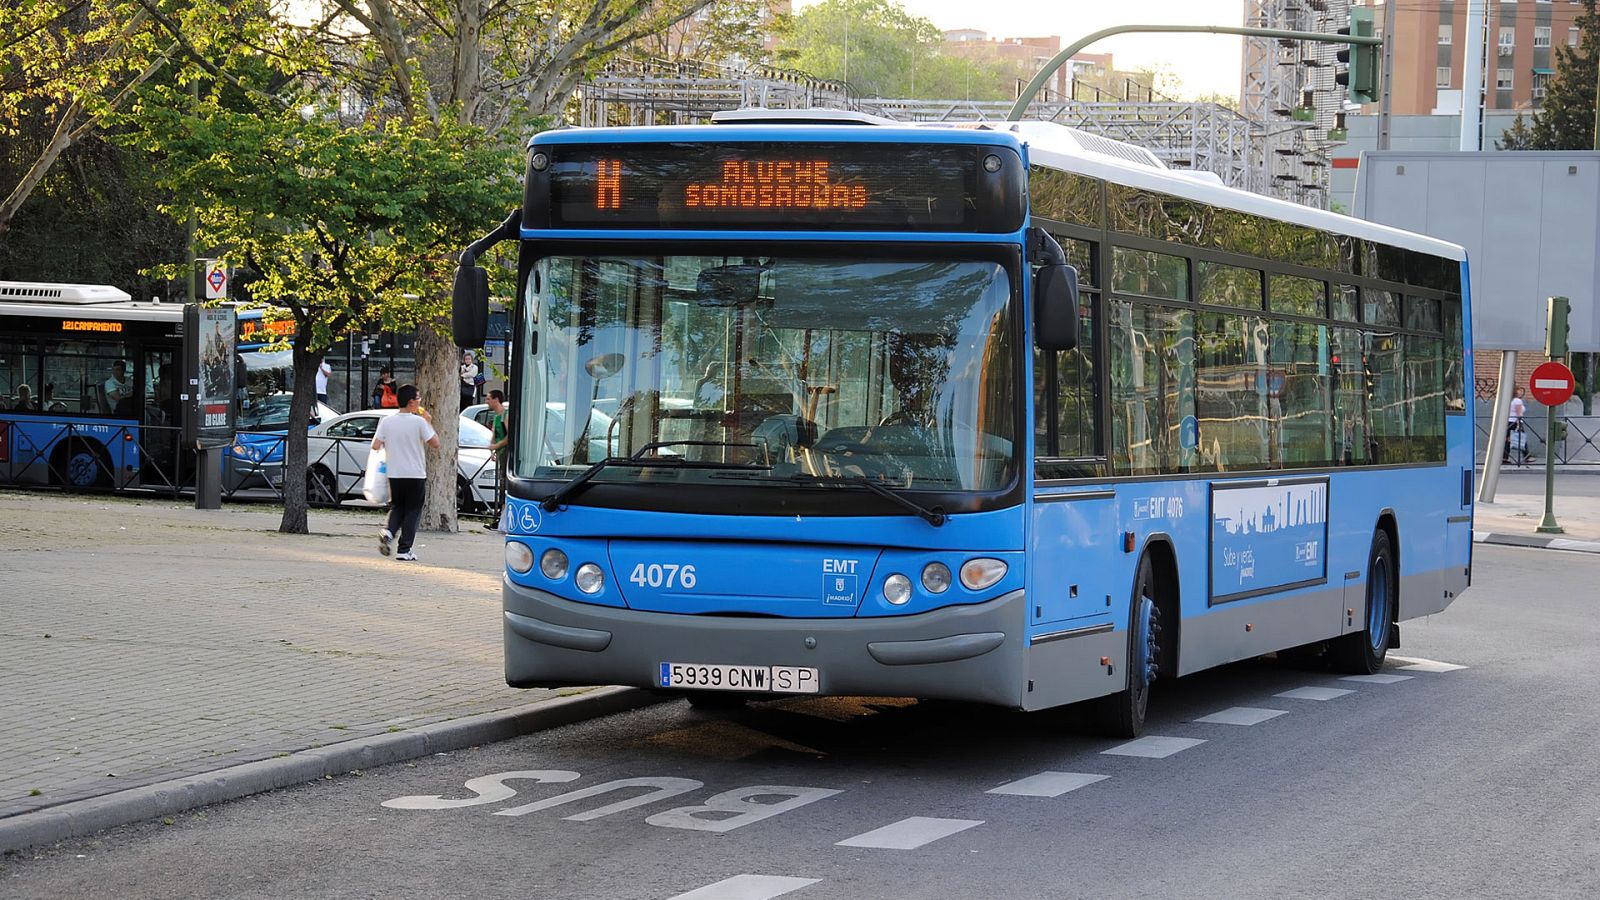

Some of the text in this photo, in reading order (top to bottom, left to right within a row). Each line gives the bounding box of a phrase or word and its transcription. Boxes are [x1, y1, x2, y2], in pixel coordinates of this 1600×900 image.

[722, 160, 829, 183] ALUCHE
[596, 160, 619, 208] H
[685, 184, 867, 207] SOMOSAGUAS
[1150, 497, 1166, 519] EMT
[1167, 496, 1184, 518] 4076
[1223, 547, 1236, 567] Sube
[1306, 541, 1318, 560] EMT
[629, 563, 697, 589] 4076
[822, 558, 858, 574] EMT
[673, 666, 765, 688] 5939 CNW
[381, 769, 843, 833] BUS
